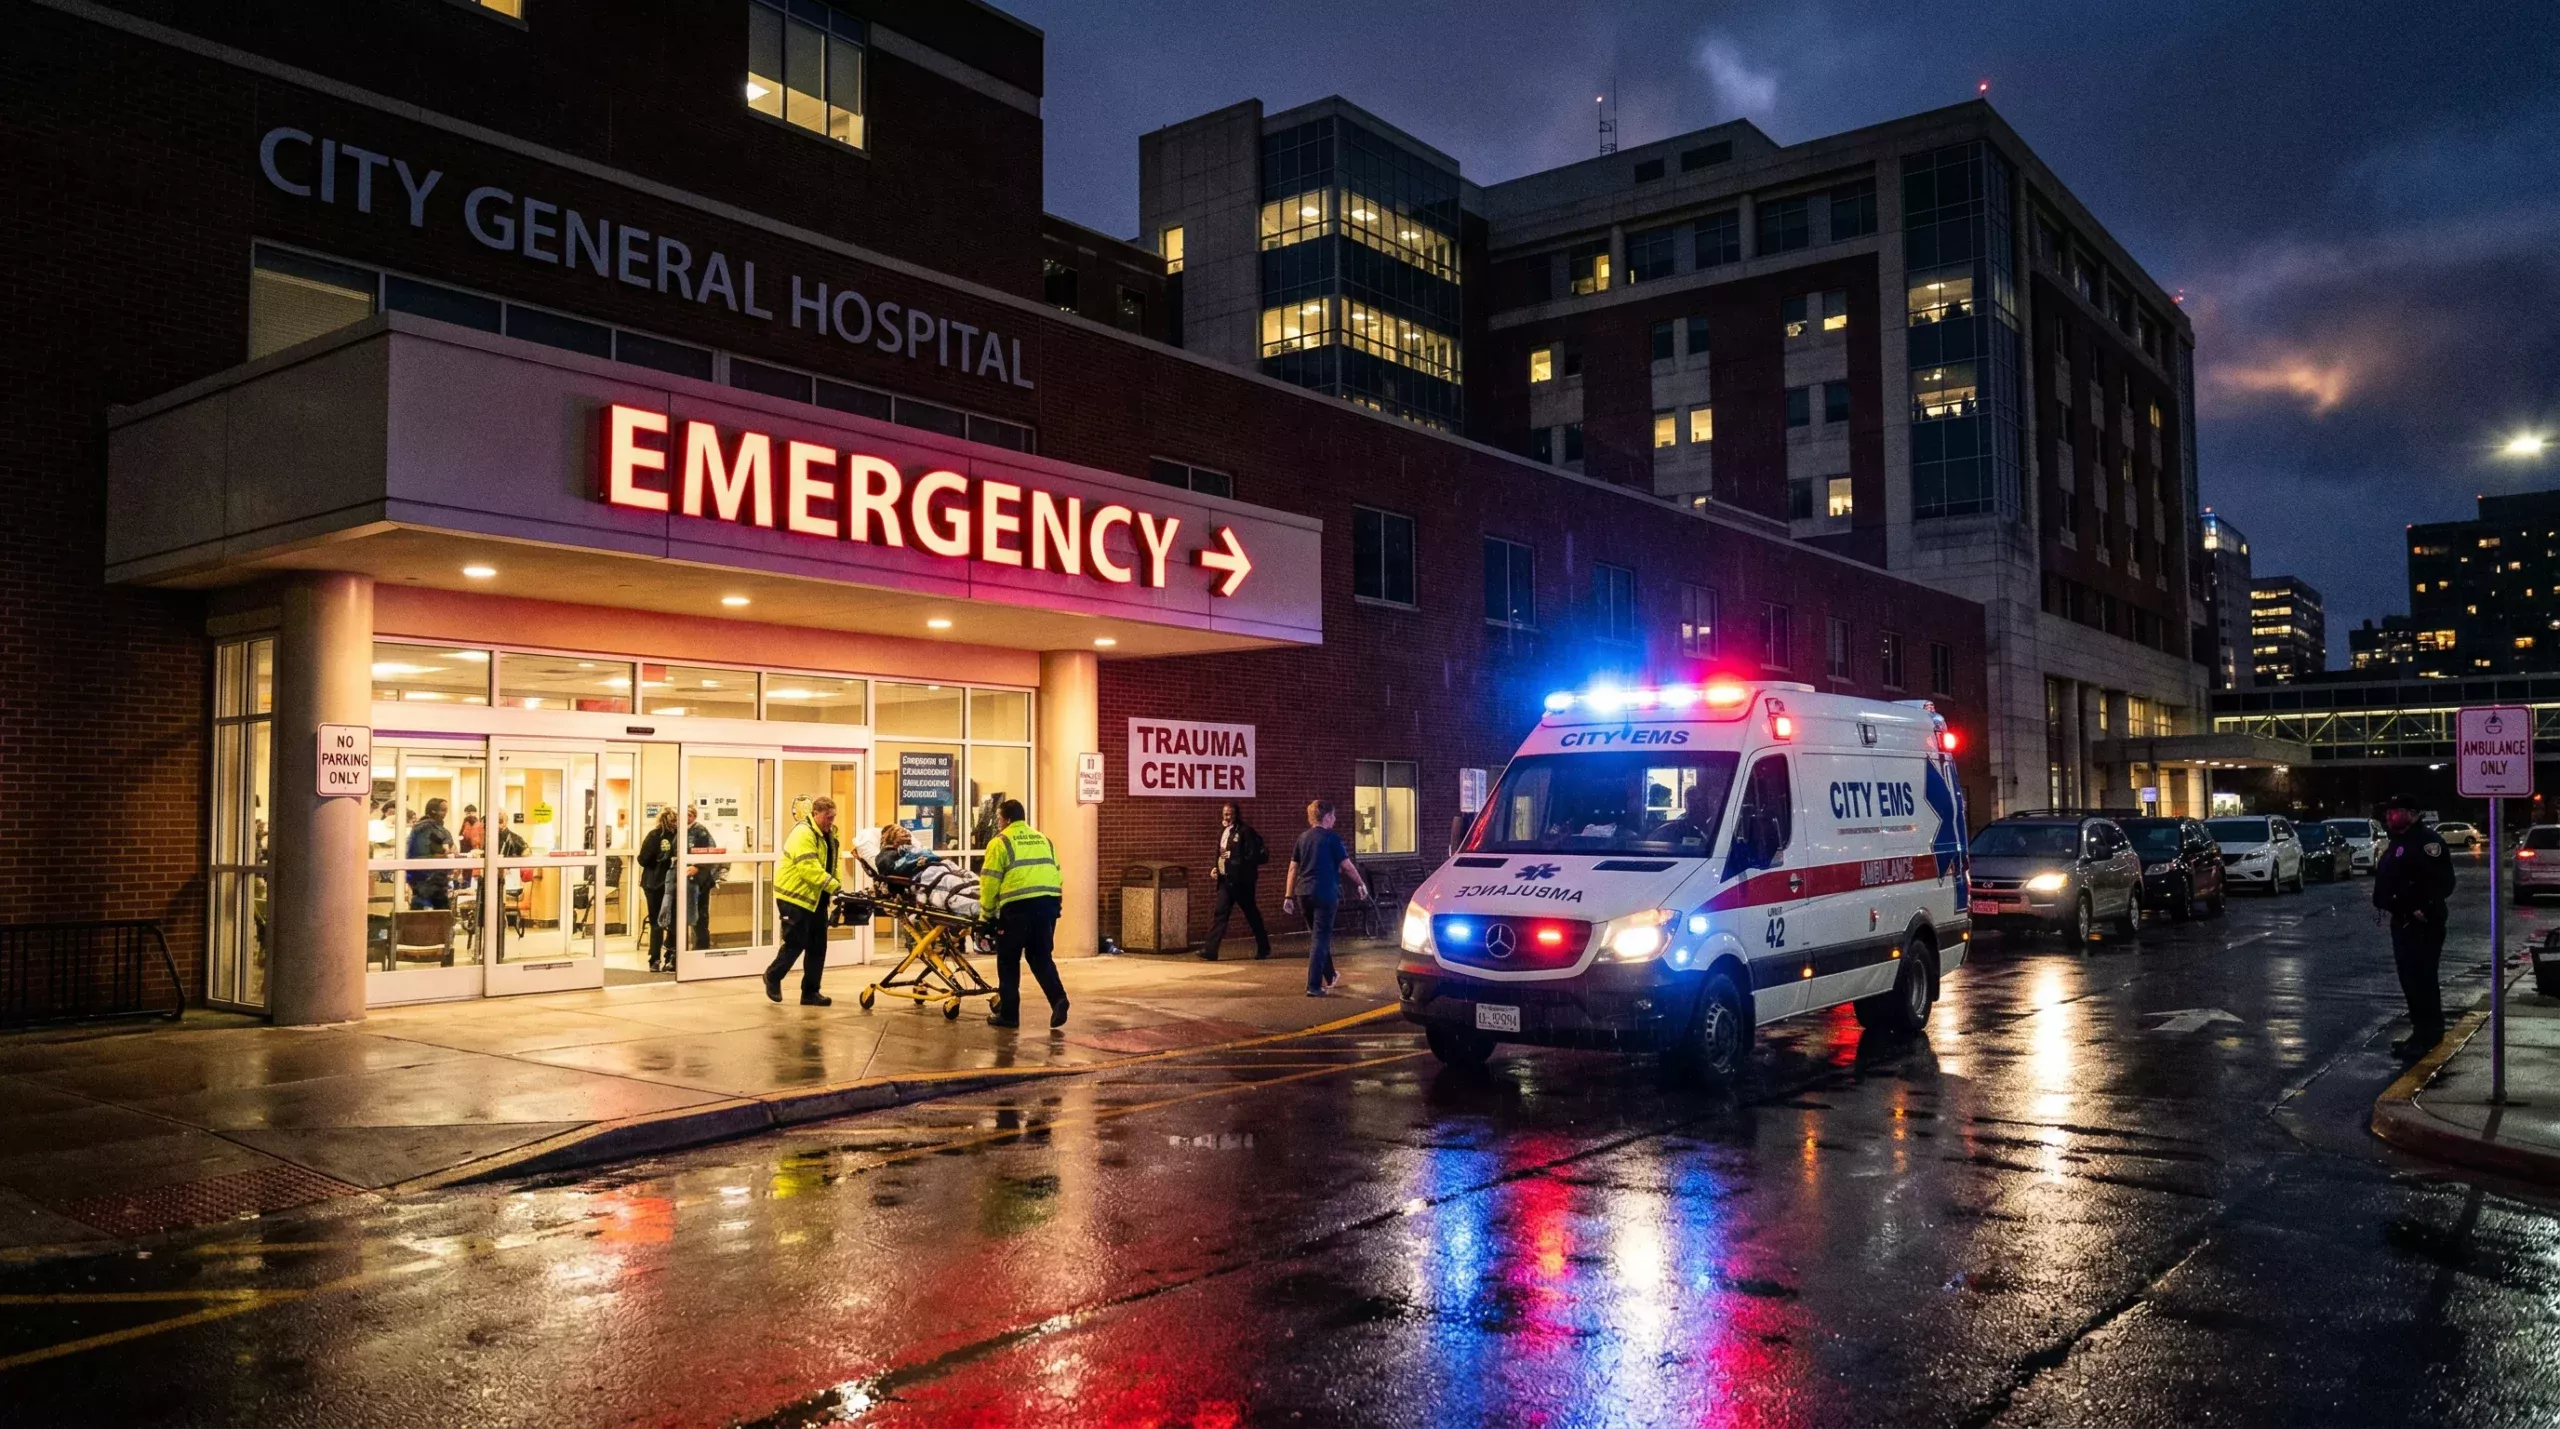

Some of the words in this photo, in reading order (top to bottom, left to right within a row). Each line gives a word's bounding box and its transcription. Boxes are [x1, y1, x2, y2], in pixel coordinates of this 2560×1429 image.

[259, 126, 443, 228] CITY
[463, 186, 773, 321] GENERAL
[791, 274, 1035, 391] HOSPITAL
[607, 403, 1181, 588] EMERGENCY
[337, 735, 354, 748] NO
[1137, 725, 1248, 758] TRAUMA
[1560, 730, 1622, 747] CITY
[1630, 729, 1690, 745] EMS
[2463, 740, 2526, 756] AMBULANCE
[322, 752, 369, 767] PARKING
[2480, 760, 2508, 776] ONLY
[329, 771, 361, 784] ONLY
[1140, 761, 1246, 791] CENTER
[1829, 781, 1872, 819] CITY
[1876, 781, 1915, 817] EMS
[1765, 916, 1785, 949] 42
